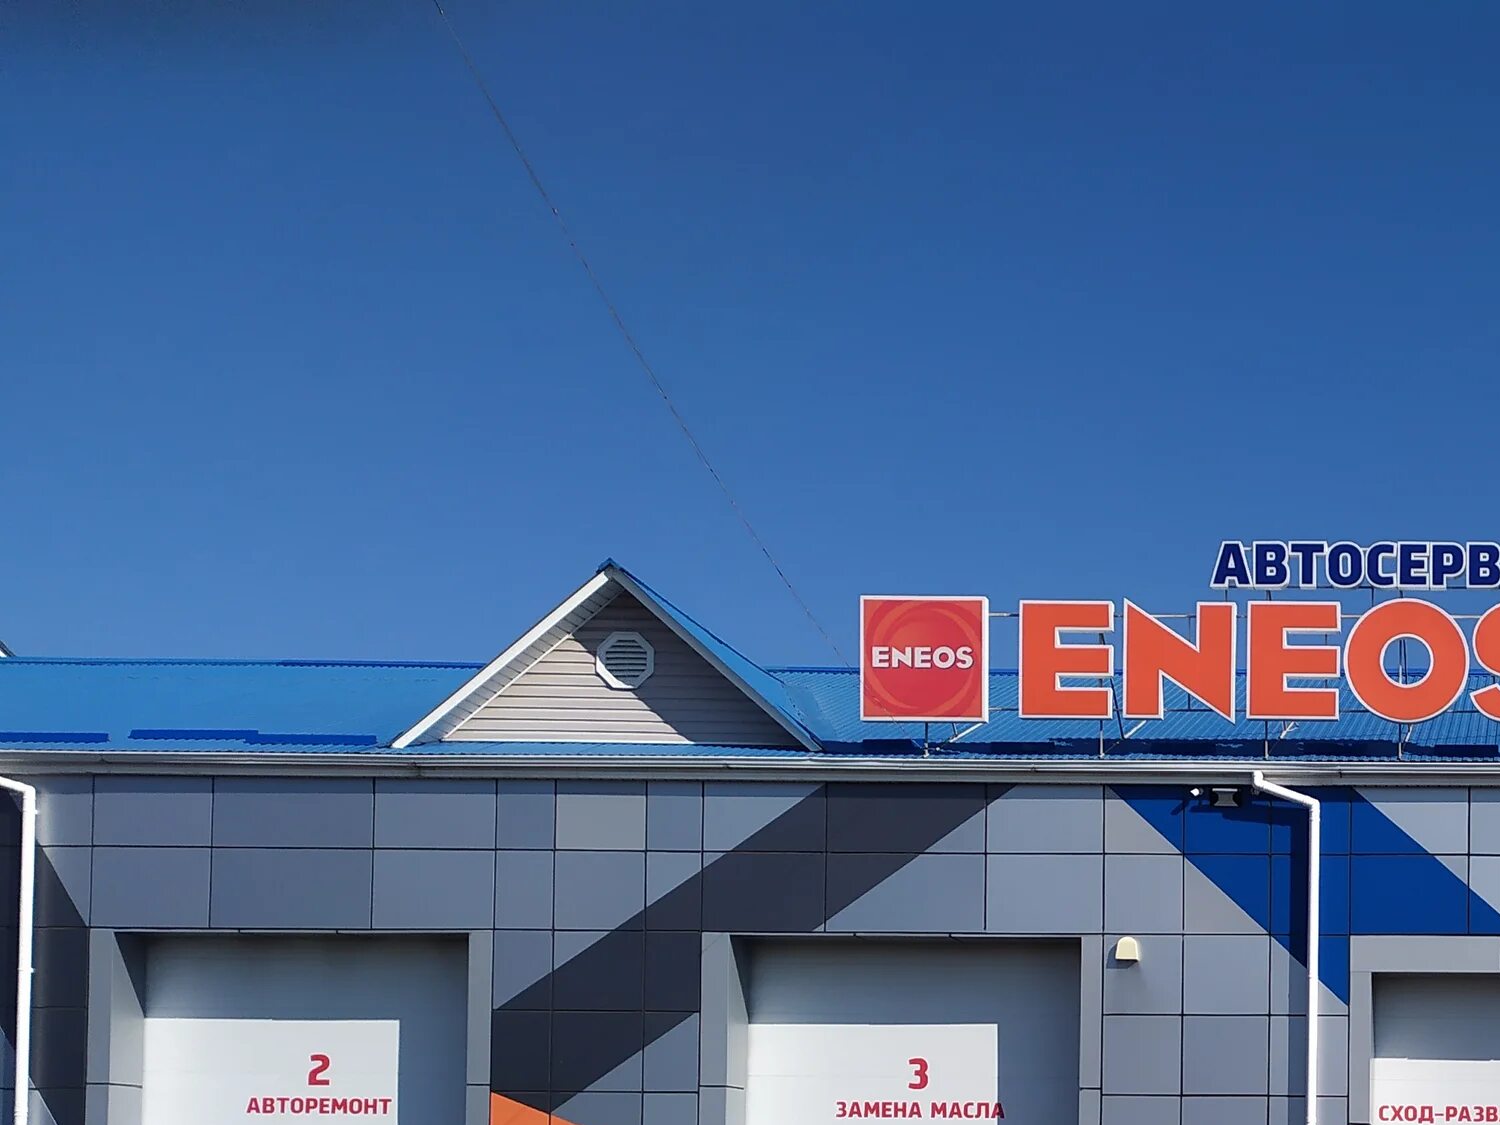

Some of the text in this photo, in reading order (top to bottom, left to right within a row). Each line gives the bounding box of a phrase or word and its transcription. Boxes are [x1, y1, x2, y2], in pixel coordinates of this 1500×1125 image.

[872, 646, 974, 669] ENEOS
[307, 1053, 331, 1086] 2
[907, 1057, 930, 1090] 3
[246, 1097, 392, 1115] АВТОРЕМОНТ
[836, 1101, 1005, 1119] ЗАМЕНА МАСЛА
